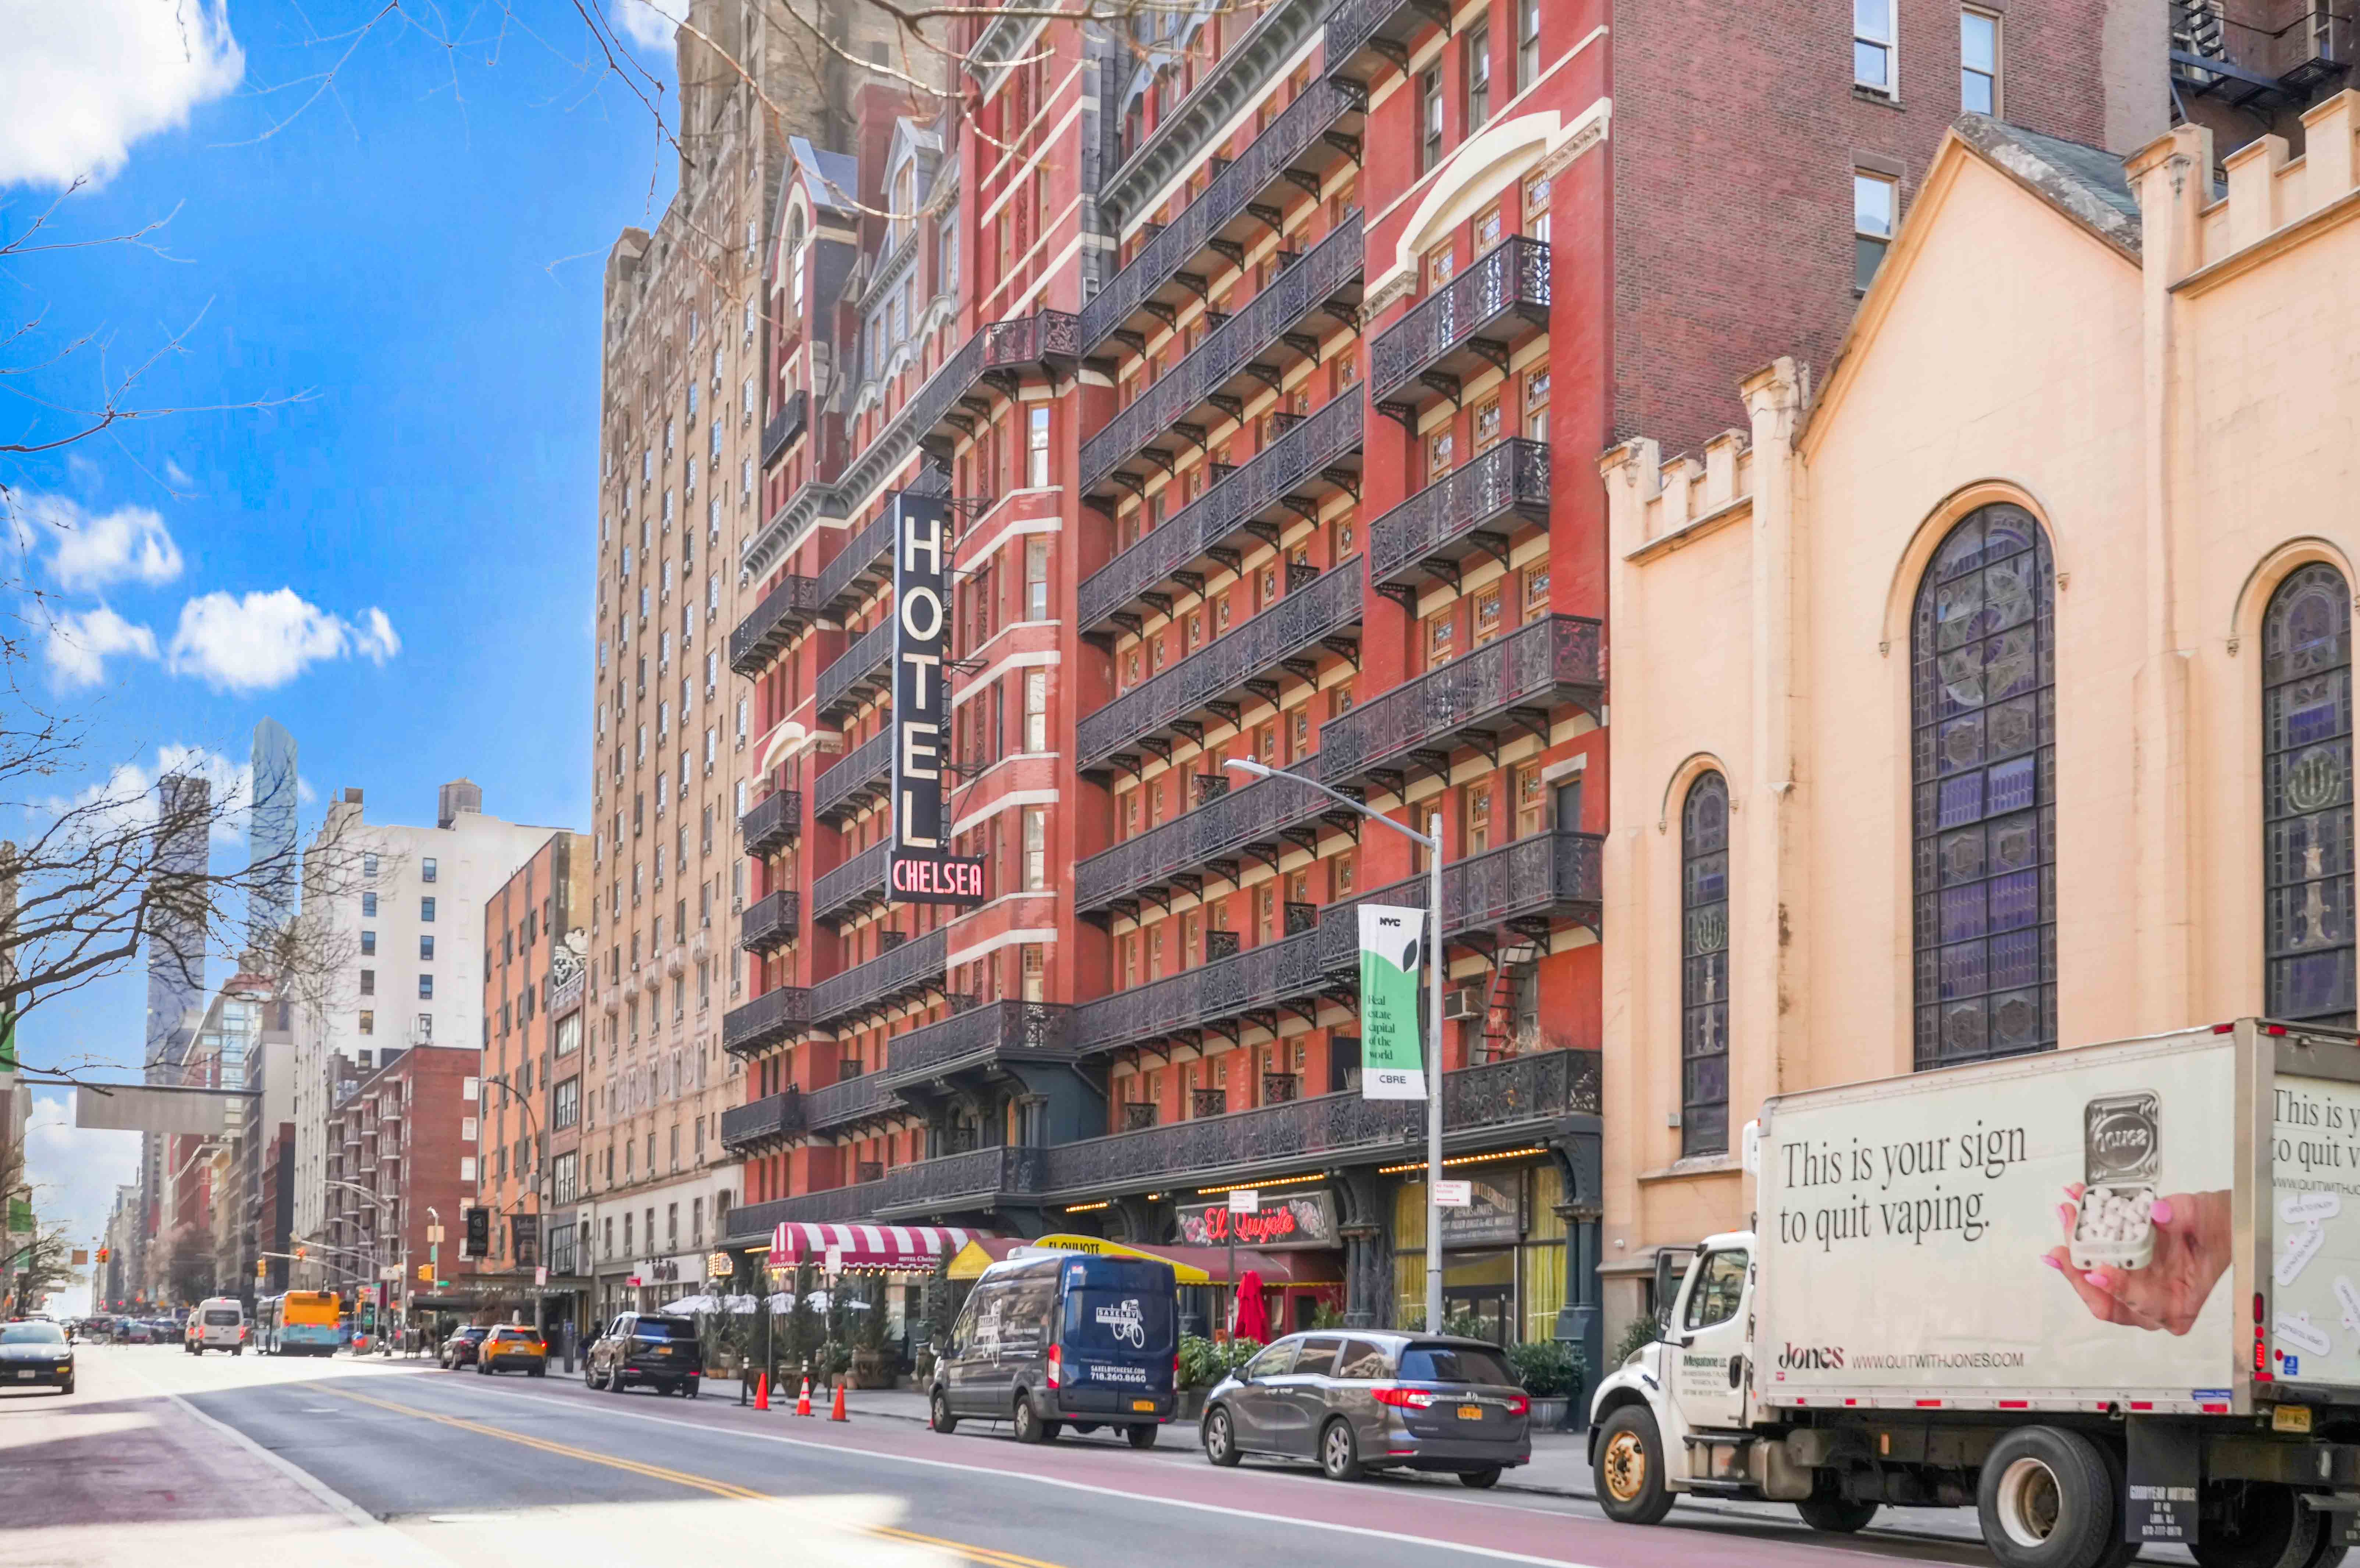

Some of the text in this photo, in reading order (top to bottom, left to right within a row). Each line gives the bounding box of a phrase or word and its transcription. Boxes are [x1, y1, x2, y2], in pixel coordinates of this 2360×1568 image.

[901, 516, 943, 849] HOTEL
[892, 859, 982, 897] CHELSEA
[1379, 917, 1401, 927] NYC
[1368, 994, 1386, 1006] Real
[1368, 1010, 1392, 1020] estate
[1368, 1023, 1396, 1034] capital
[1368, 1035, 1391, 1046] of the
[1369, 1049, 1393, 1061] world
[1379, 1075, 1407, 1085] CBRE
[2273, 1088, 2318, 1126] This
[2325, 1097, 2343, 1128] is
[1781, 1119, 2027, 1191] This is your sign
[2298, 1136, 2341, 1172] quit
[1205, 1208, 1229, 1239] El
[1780, 1184, 1990, 1252] to quit vaping.
[1098, 1309, 1137, 1318] SAXELBY
[1778, 1342, 2025, 1370] Jones WWW.QUITWITHJONES.COM
